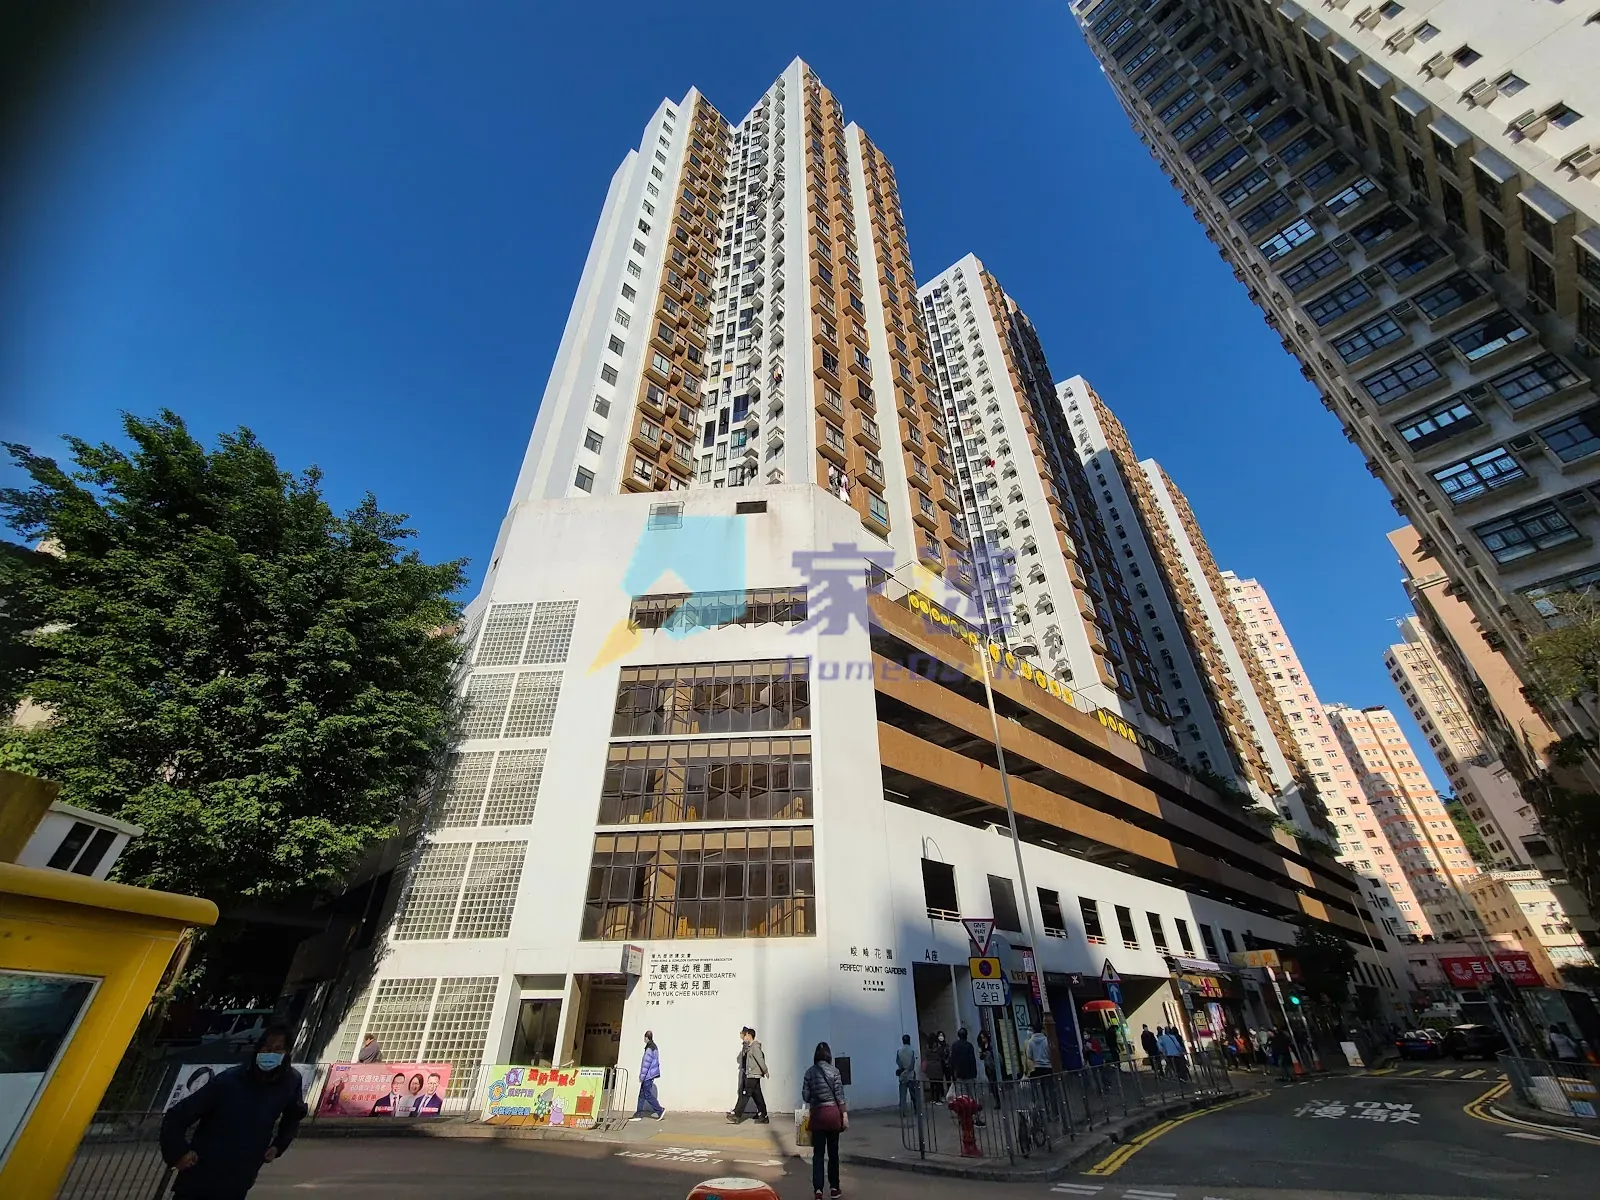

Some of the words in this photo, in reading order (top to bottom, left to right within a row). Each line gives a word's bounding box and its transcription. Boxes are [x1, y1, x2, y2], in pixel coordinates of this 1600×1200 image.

[925, 949, 939, 961] A座
[840, 964, 863, 972] PERFECT
[865, 965, 882, 974] MOUNT
[885, 966, 907, 975] GARDENS
[981, 992, 999, 1004] 全日
